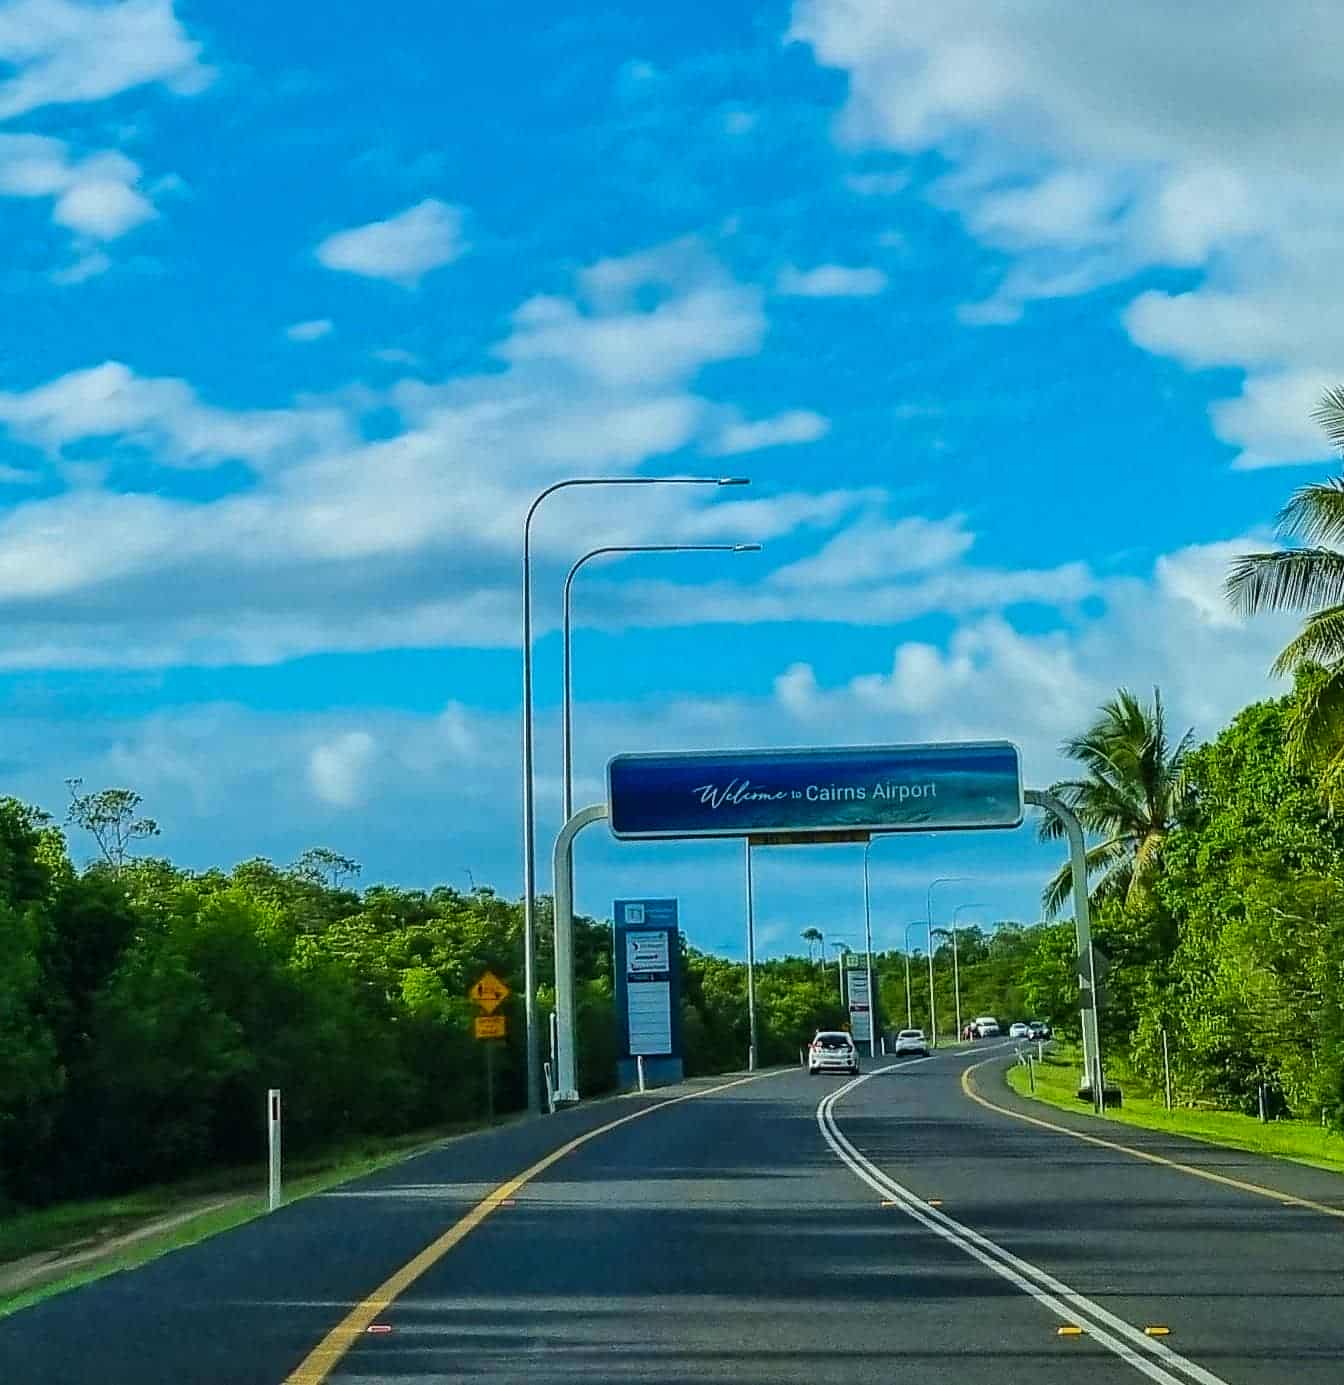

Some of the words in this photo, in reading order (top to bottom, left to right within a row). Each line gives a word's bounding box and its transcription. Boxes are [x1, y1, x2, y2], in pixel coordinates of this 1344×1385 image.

[692, 777, 787, 809] Welcome
[791, 789, 802, 799] to
[805, 783, 867, 802] Cairns
[872, 781, 937, 803] Airport
